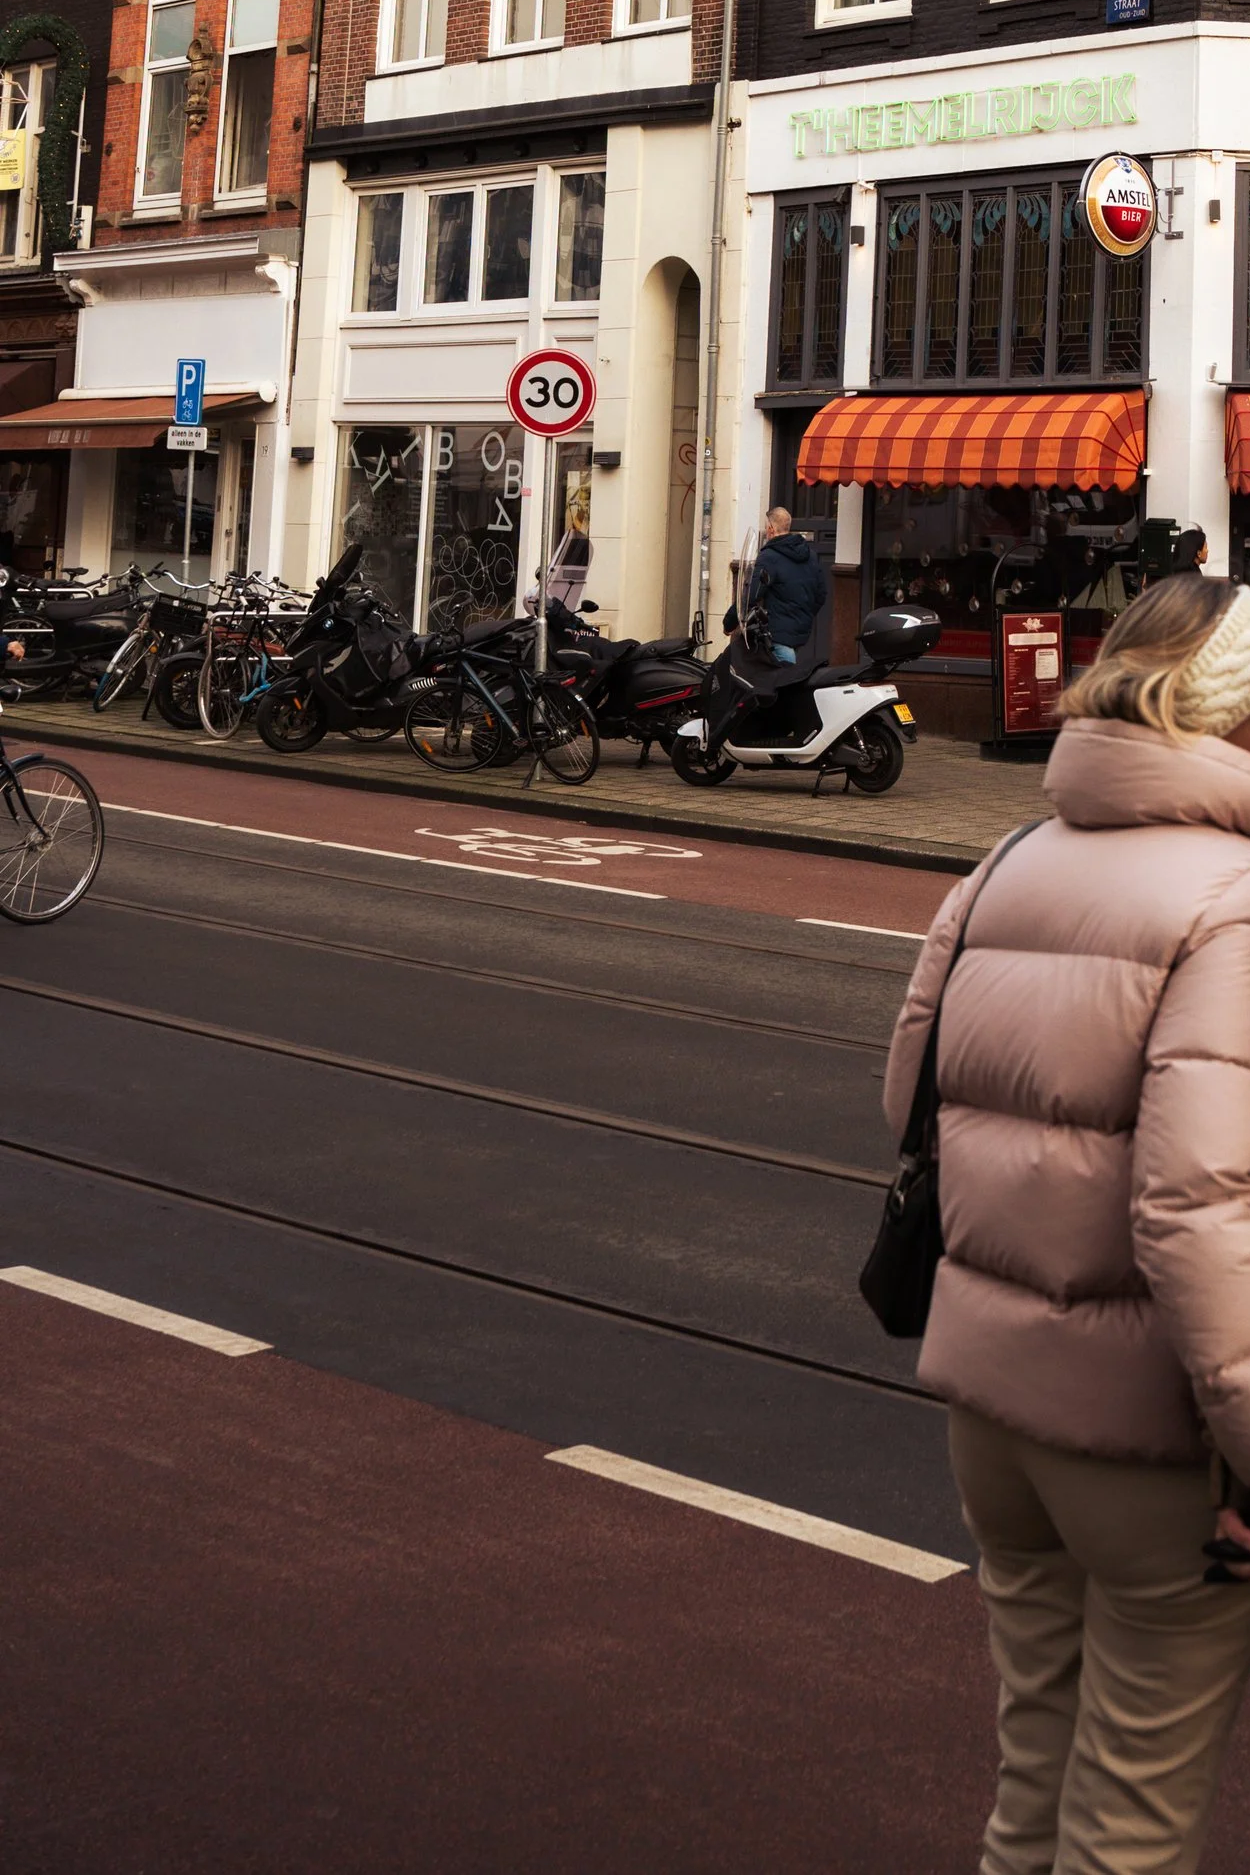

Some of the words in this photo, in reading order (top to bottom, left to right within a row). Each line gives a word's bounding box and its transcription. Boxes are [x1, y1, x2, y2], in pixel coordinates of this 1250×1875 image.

[1106, 188, 1151, 208] AMSTEL
[1121, 210, 1142, 223] BIER
[182, 364, 196, 396] P
[525, 376, 579, 408] 30
